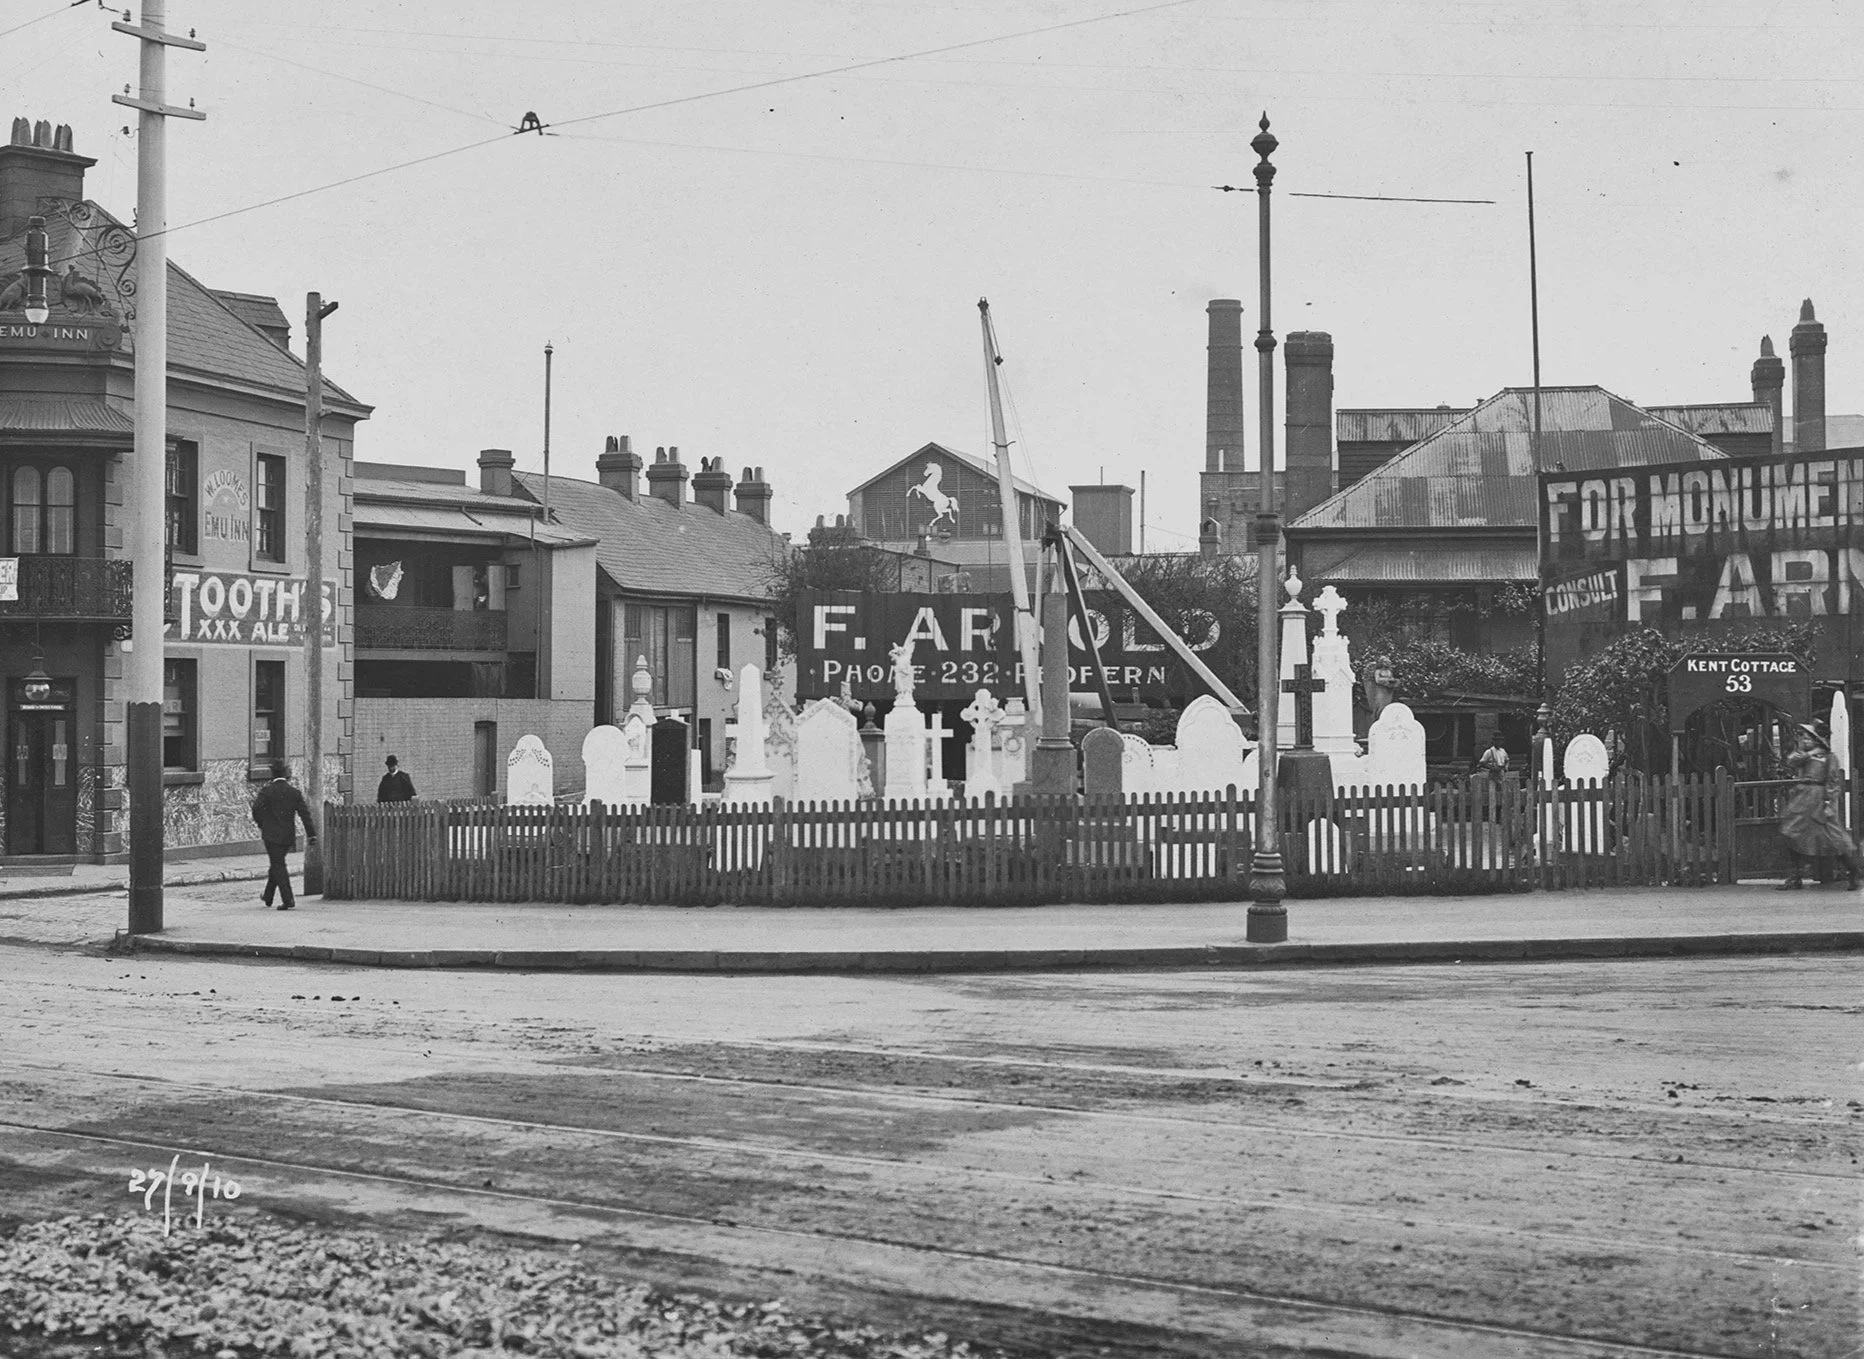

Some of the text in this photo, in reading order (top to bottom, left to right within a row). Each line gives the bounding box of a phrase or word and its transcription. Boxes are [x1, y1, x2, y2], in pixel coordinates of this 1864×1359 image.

[0, 325, 88, 340] EMU INN
[1546, 458, 1864, 543] FOR MONUMEN
[204, 510, 250, 542] EMU INN
[1545, 569, 1618, 616] CONSULT
[1626, 556, 1697, 622] F.
[197, 618, 242, 642] XXX
[251, 621, 290, 643] ALE
[813, 605, 1221, 652] F. AROLD
[940, 660, 1000, 684] 232
[1687, 658, 1797, 673] KENT COTTAGE
[1725, 674, 1753, 693] 53
